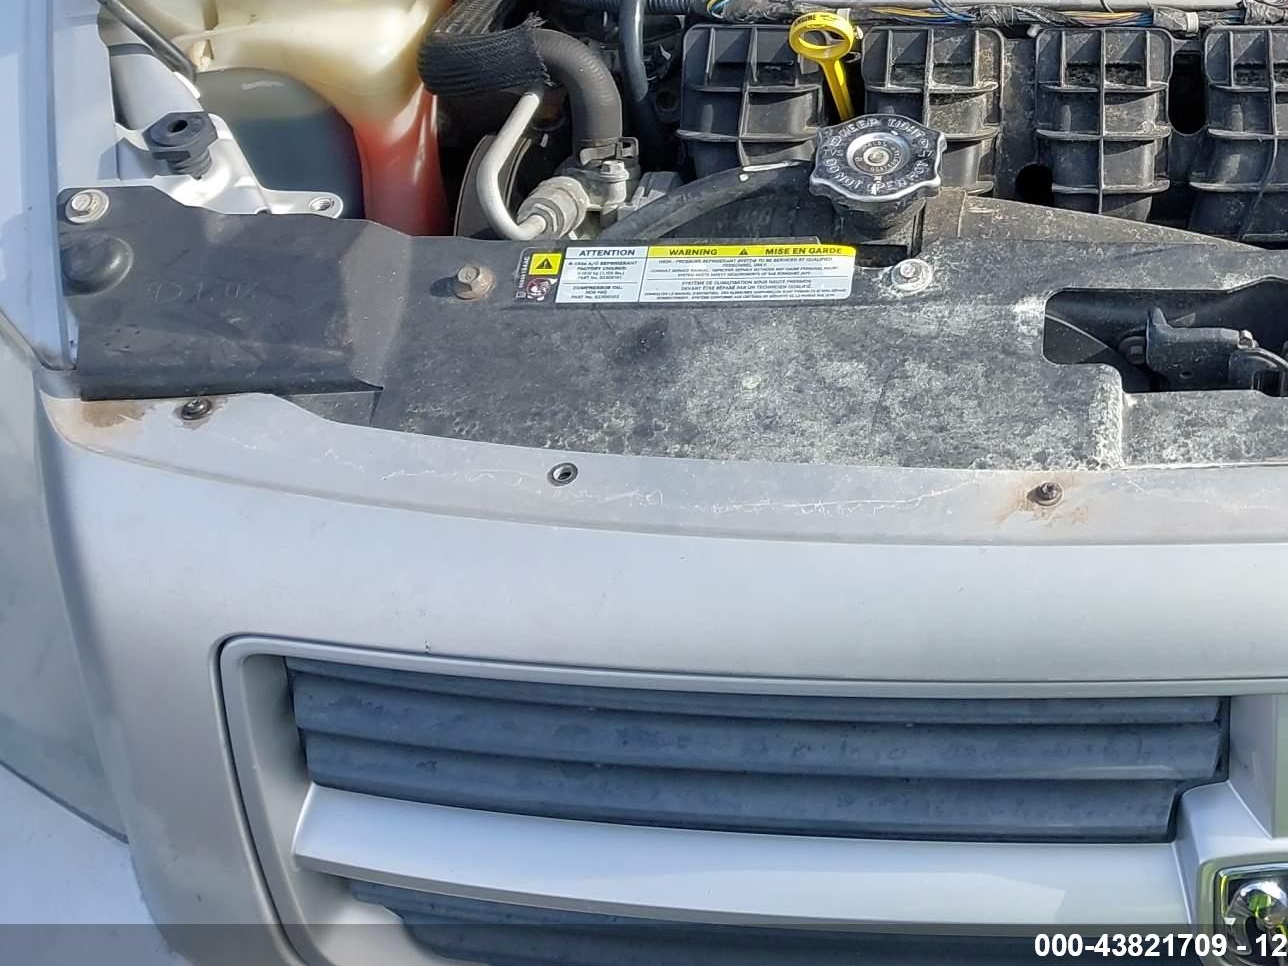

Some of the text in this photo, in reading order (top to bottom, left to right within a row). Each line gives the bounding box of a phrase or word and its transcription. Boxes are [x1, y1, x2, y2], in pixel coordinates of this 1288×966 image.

[579, 249, 636, 257] ATTENTION
[669, 248, 718, 256] WARNING
[764, 247, 842, 255] MISE EN GARDE
